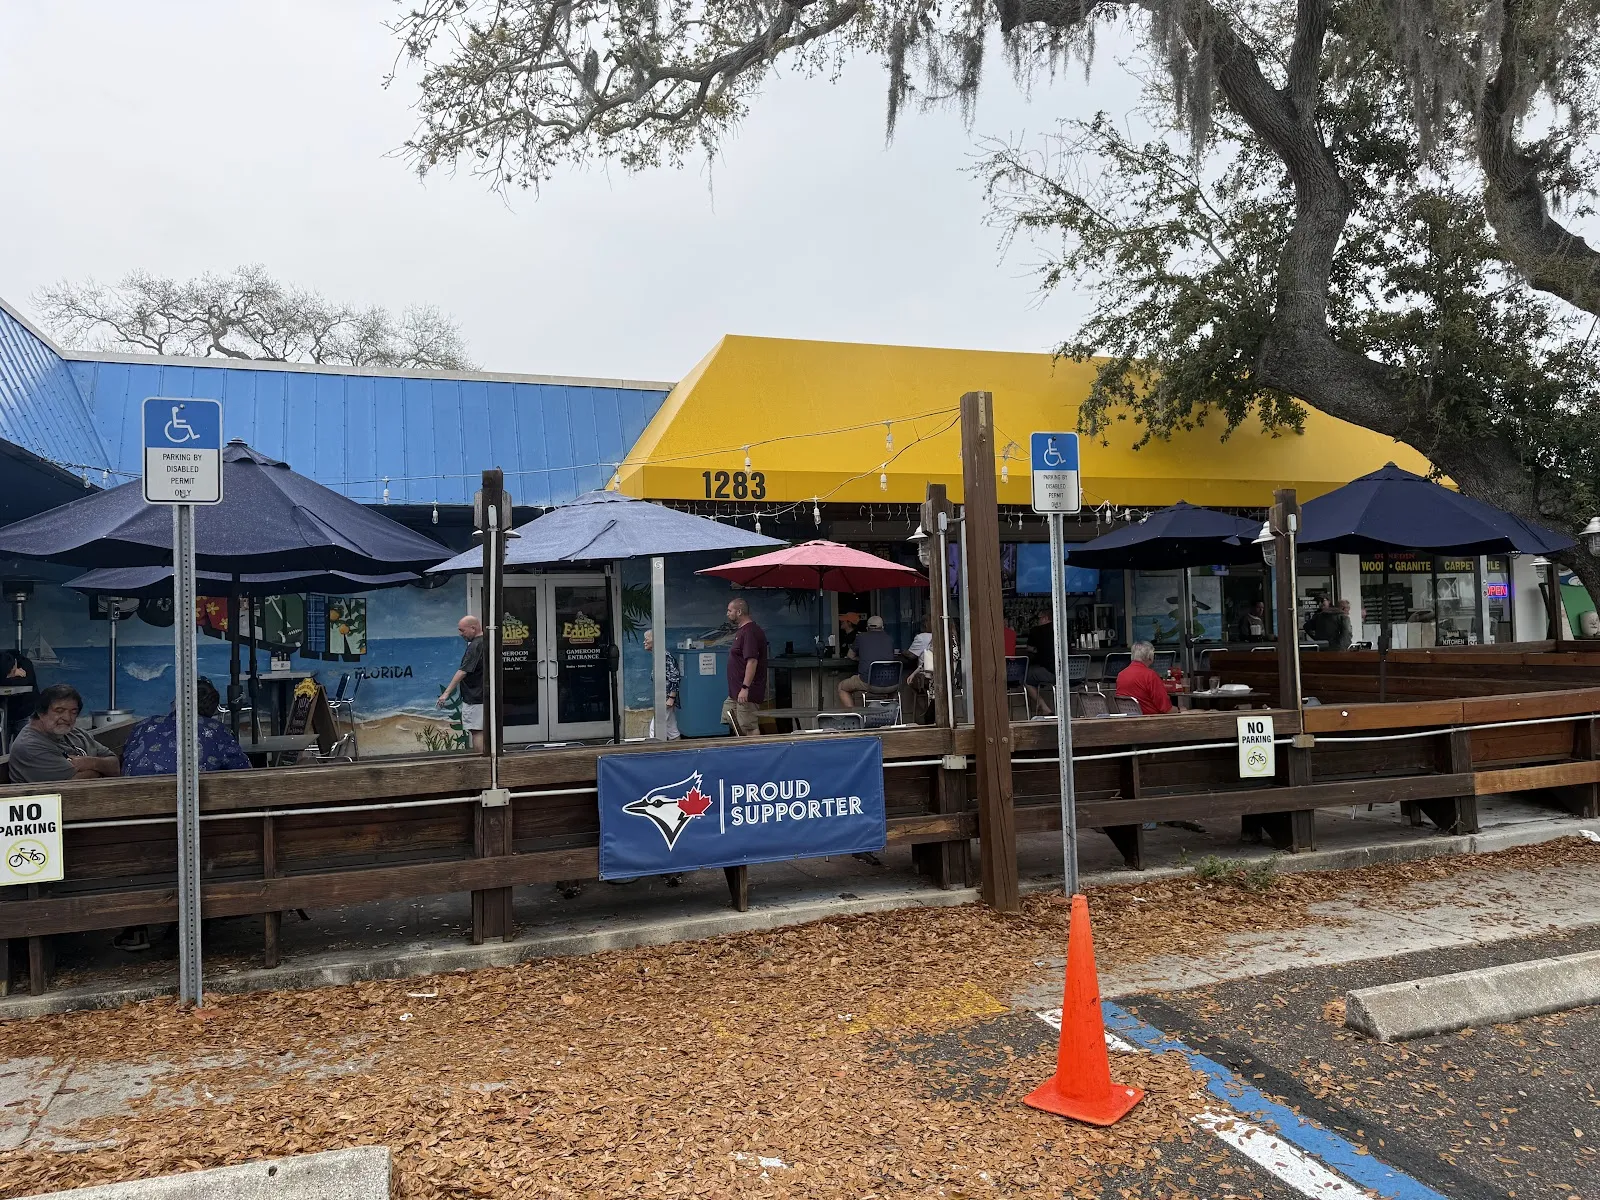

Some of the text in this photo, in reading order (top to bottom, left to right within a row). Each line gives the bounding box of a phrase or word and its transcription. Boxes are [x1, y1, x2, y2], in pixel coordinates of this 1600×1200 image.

[162, 453, 203, 462] PARKING BY
[166, 465, 199, 473] DISABLED
[170, 477, 195, 485] PERMIT
[702, 470, 767, 500] 1283
[1394, 561, 1431, 572] GRANITE
[1487, 560, 1500, 570] ILE
[353, 665, 413, 680] FLORIDA
[1247, 721, 1264, 734] NO
[1242, 735, 1272, 743] PARKING
[731, 779, 811, 804] PROUD
[9, 803, 42, 822] NO
[731, 796, 864, 826] SUPPORTER
